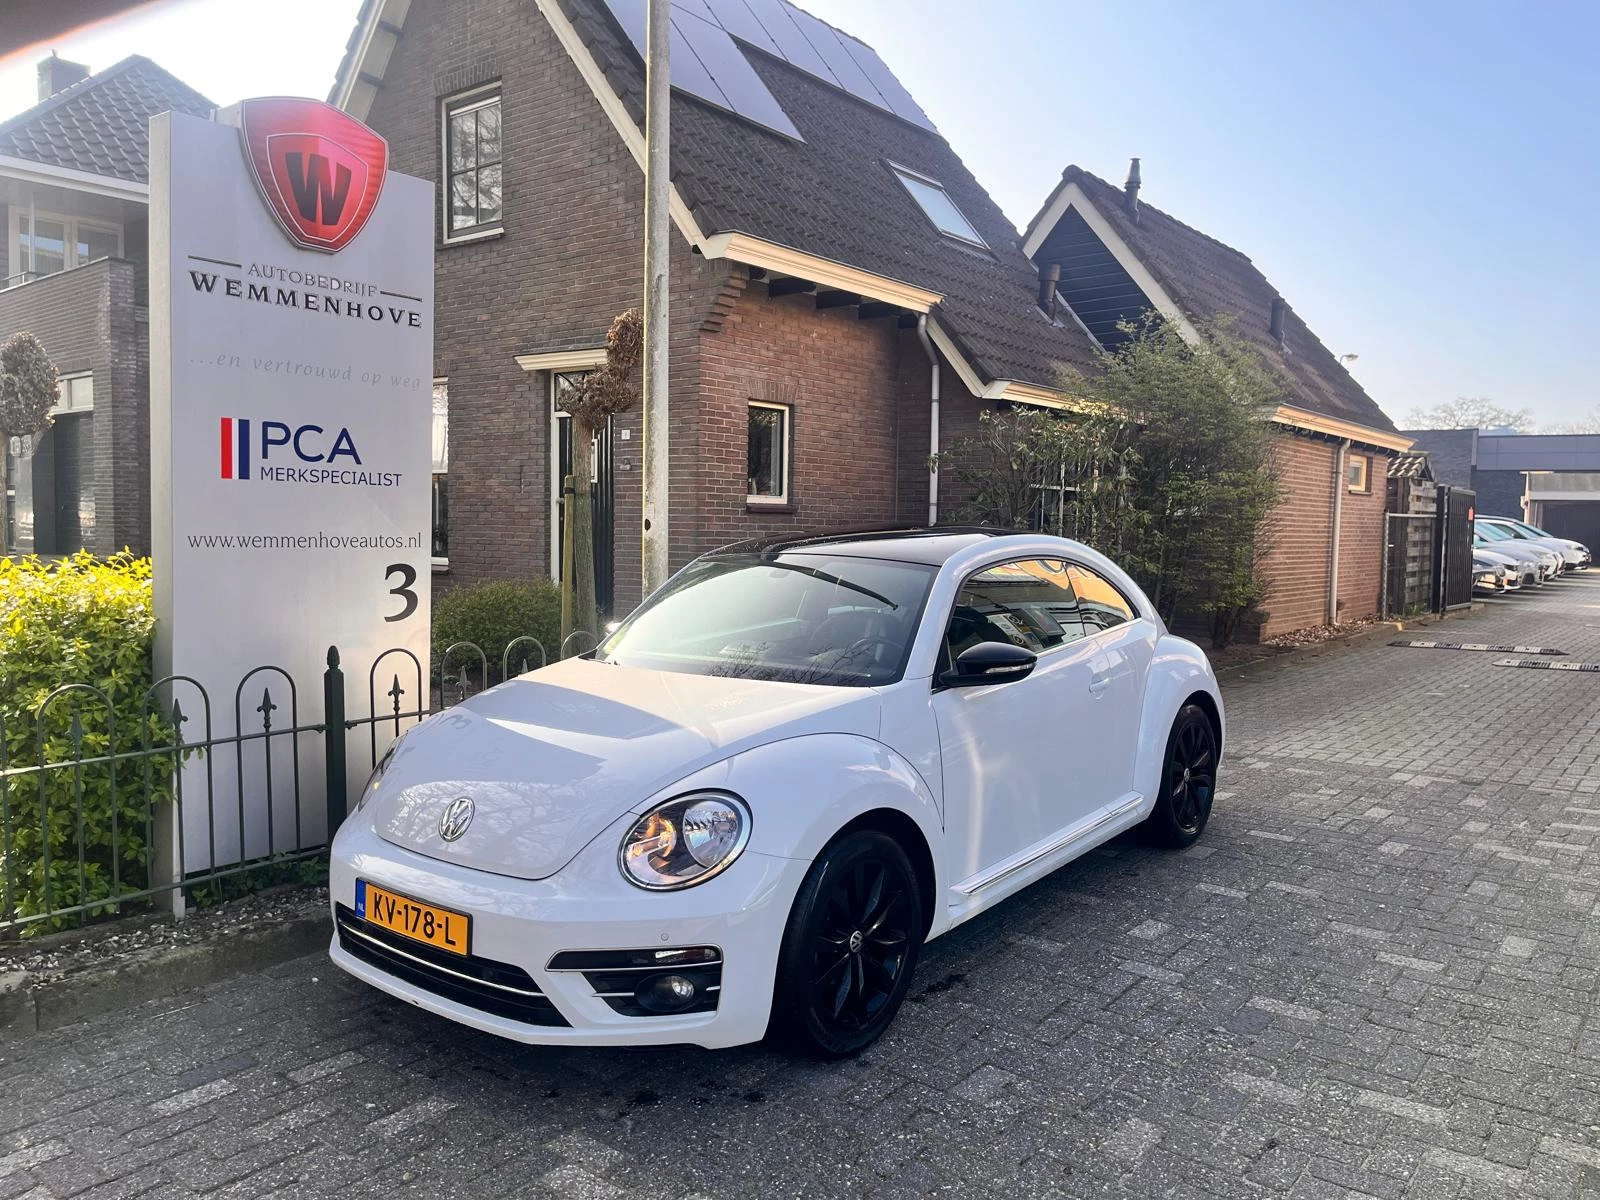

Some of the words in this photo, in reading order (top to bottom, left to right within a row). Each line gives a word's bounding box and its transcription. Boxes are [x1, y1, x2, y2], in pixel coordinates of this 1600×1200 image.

[285, 151, 352, 226] W
[188, 270, 423, 329] WEMMENHOVE
[252, 357, 352, 382] vertrouwd
[361, 371, 382, 385] op
[390, 375, 422, 392] weg
[261, 421, 362, 465] PCA
[260, 466, 402, 487] MERKSPECIALIST
[187, 531, 422, 549] www.wemmenhoveautos.nl
[383, 563, 419, 623] 3
[373, 891, 456, 946] KV-178-L
